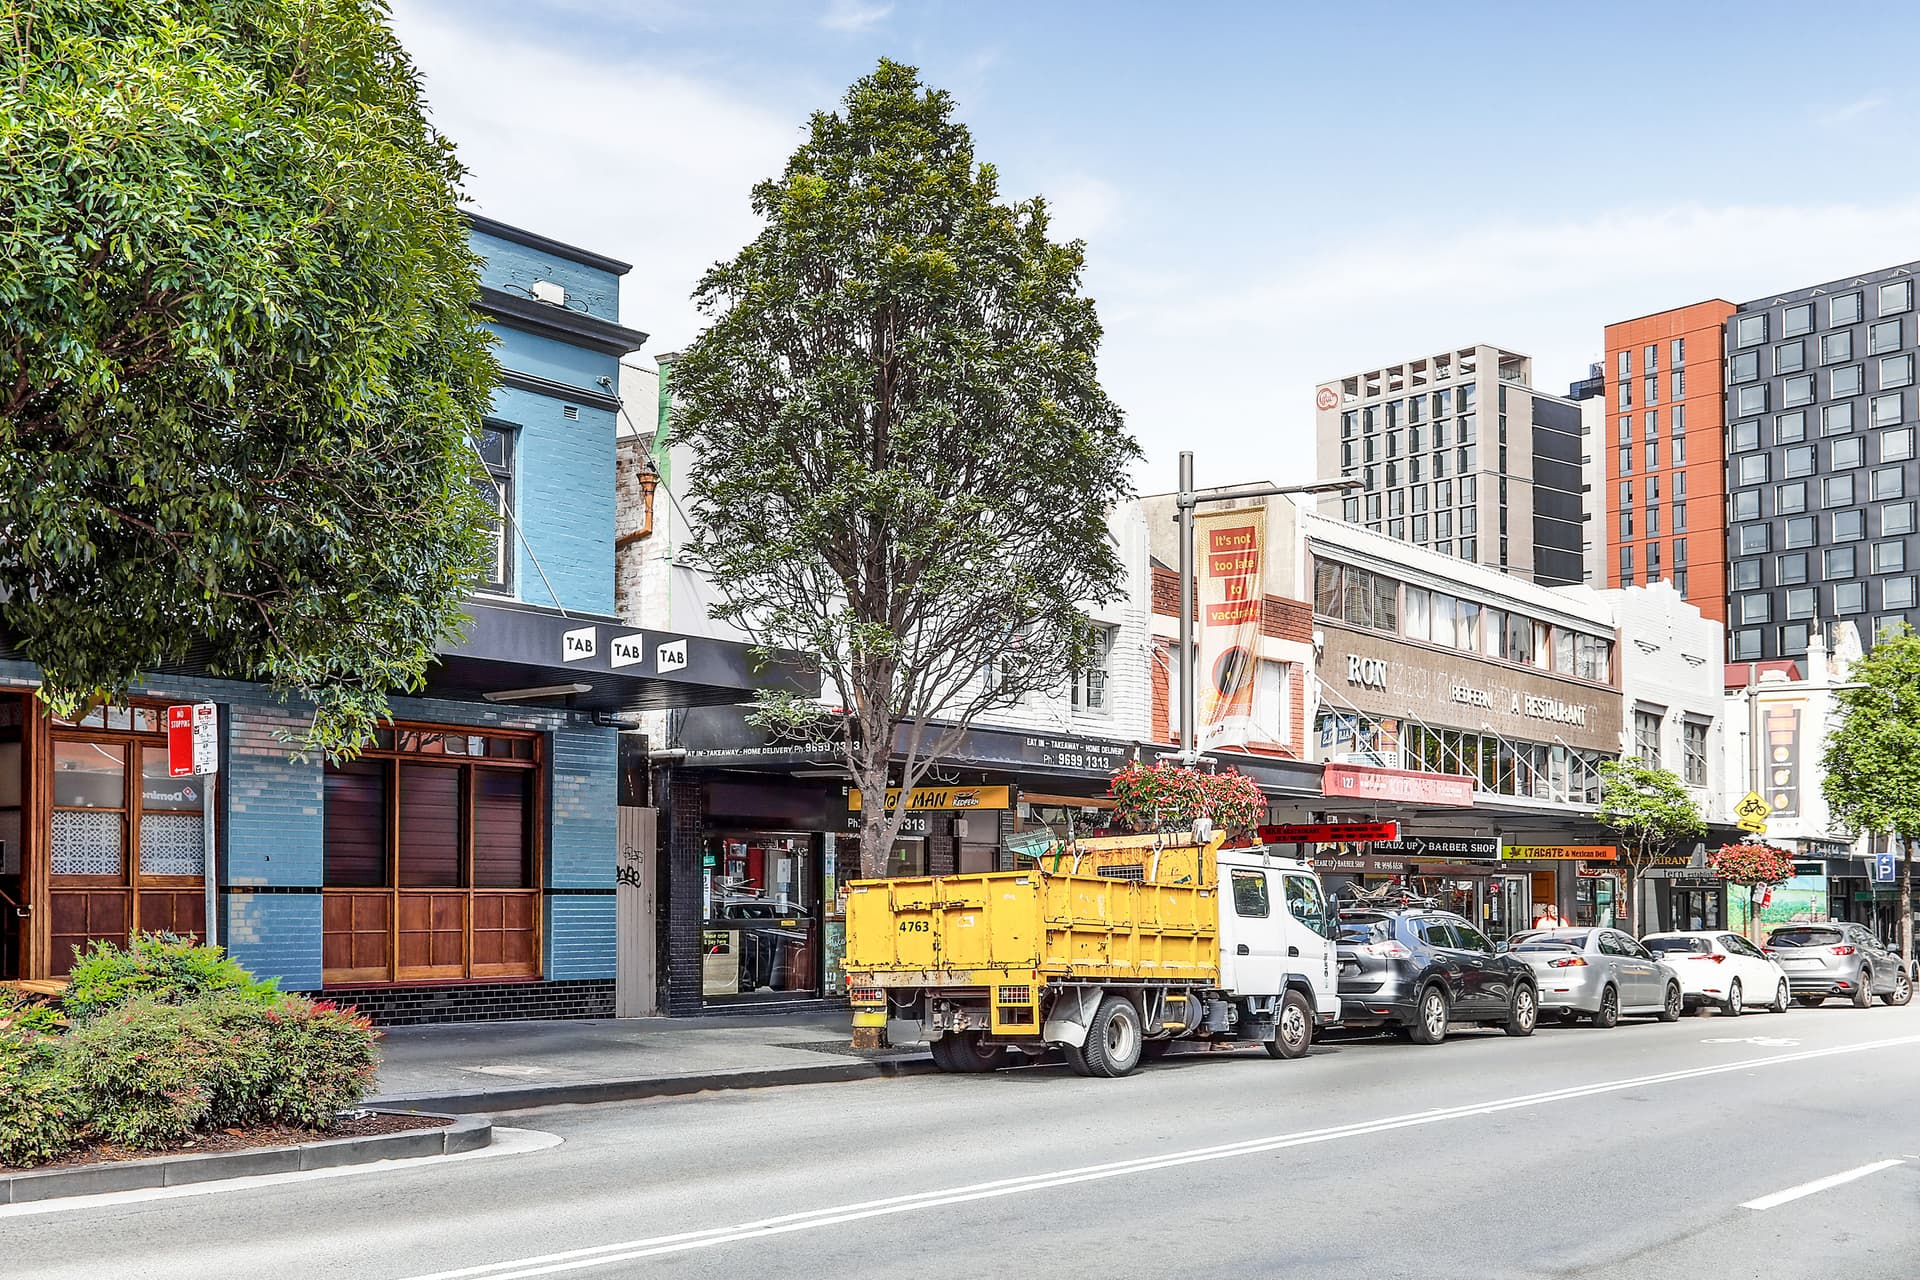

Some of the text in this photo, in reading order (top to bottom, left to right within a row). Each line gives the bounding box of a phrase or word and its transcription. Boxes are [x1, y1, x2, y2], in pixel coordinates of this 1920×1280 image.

[1215, 533, 1251, 546] It's not
[1214, 559, 1255, 571] too late
[1230, 584, 1242, 594] to
[567, 637, 593, 652] TAB
[614, 644, 640, 659] TAB
[660, 650, 684, 664] TAB
[1346, 654, 1387, 688] RON
[176, 710, 185, 719] NO
[1511, 694, 1586, 728] A RESTAURANT
[170, 719, 191, 729] STOPPING
[1026, 738, 1037, 747] EAT
[1038, 740, 1045, 748] IN
[1051, 741, 1079, 751] TAKEAWAY
[1085, 745, 1101, 754] HOME
[1101, 746, 1125, 756] DELIVERY
[1058, 753, 1083, 767] 9699
[1085, 755, 1109, 769] 1313
[1343, 777, 1354, 789] 127
[912, 792, 947, 808] MAN
[952, 798, 979, 807] REDFERN
[1374, 840, 1496, 853] HEADZ UP BARBER SHOP
[1571, 850, 1594, 858] Mexican
[1595, 850, 1607, 858] Deli
[1880, 865, 1891, 879] P
[899, 921, 929, 932] 4763
